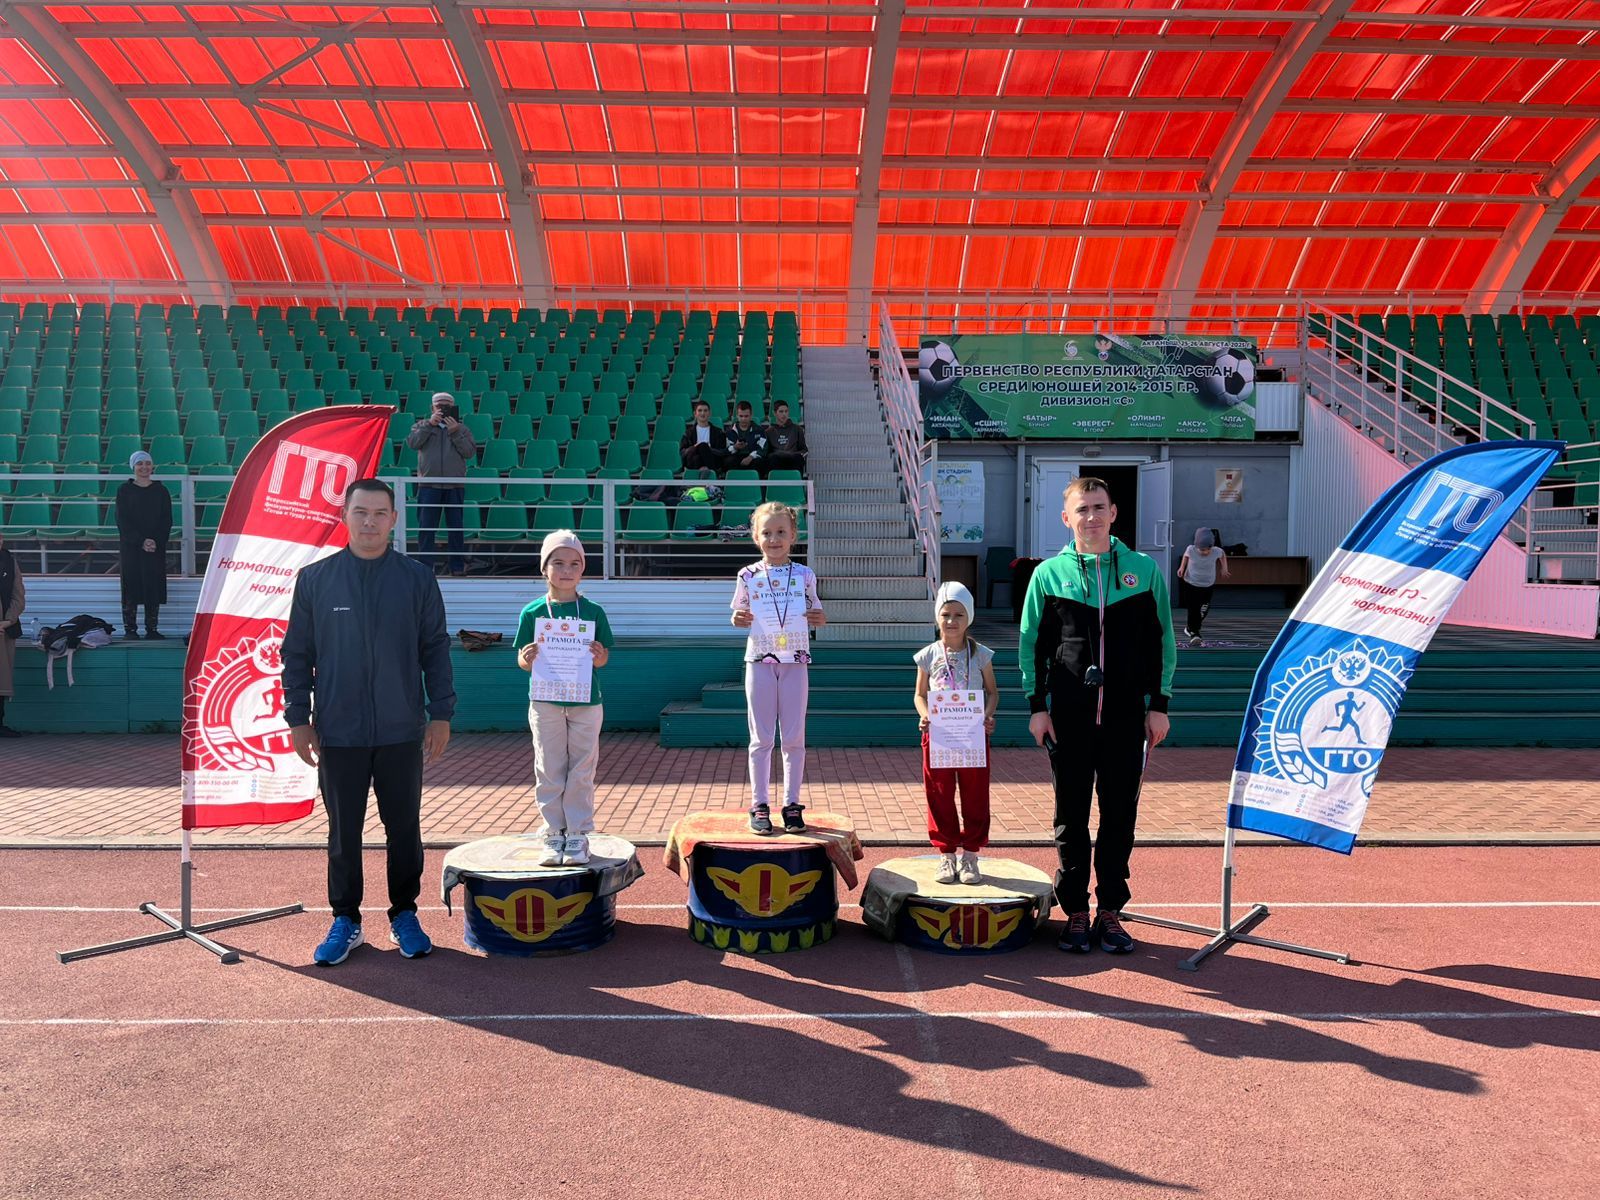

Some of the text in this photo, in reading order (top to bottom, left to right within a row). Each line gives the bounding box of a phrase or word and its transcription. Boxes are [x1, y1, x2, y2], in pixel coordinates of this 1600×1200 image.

[942, 364, 1233, 378] ПЕРВЕНСТВО РЕСПУБЛИКИ ТАТАРСТАН
[978, 379, 1200, 394] СРЕДИ ЮНОШЕЙ 2014-2015 Г.Р.
[1040, 396, 1134, 407] ДИВИЗИОН «С»
[267, 440, 358, 507] ГТО
[1406, 470, 1504, 533] ГТО
[217, 556, 293, 577] Норматив
[547, 636, 581, 644] ГРАМОТА
[261, 733, 291, 752] ГТ
[1323, 749, 1372, 768] ГТО
